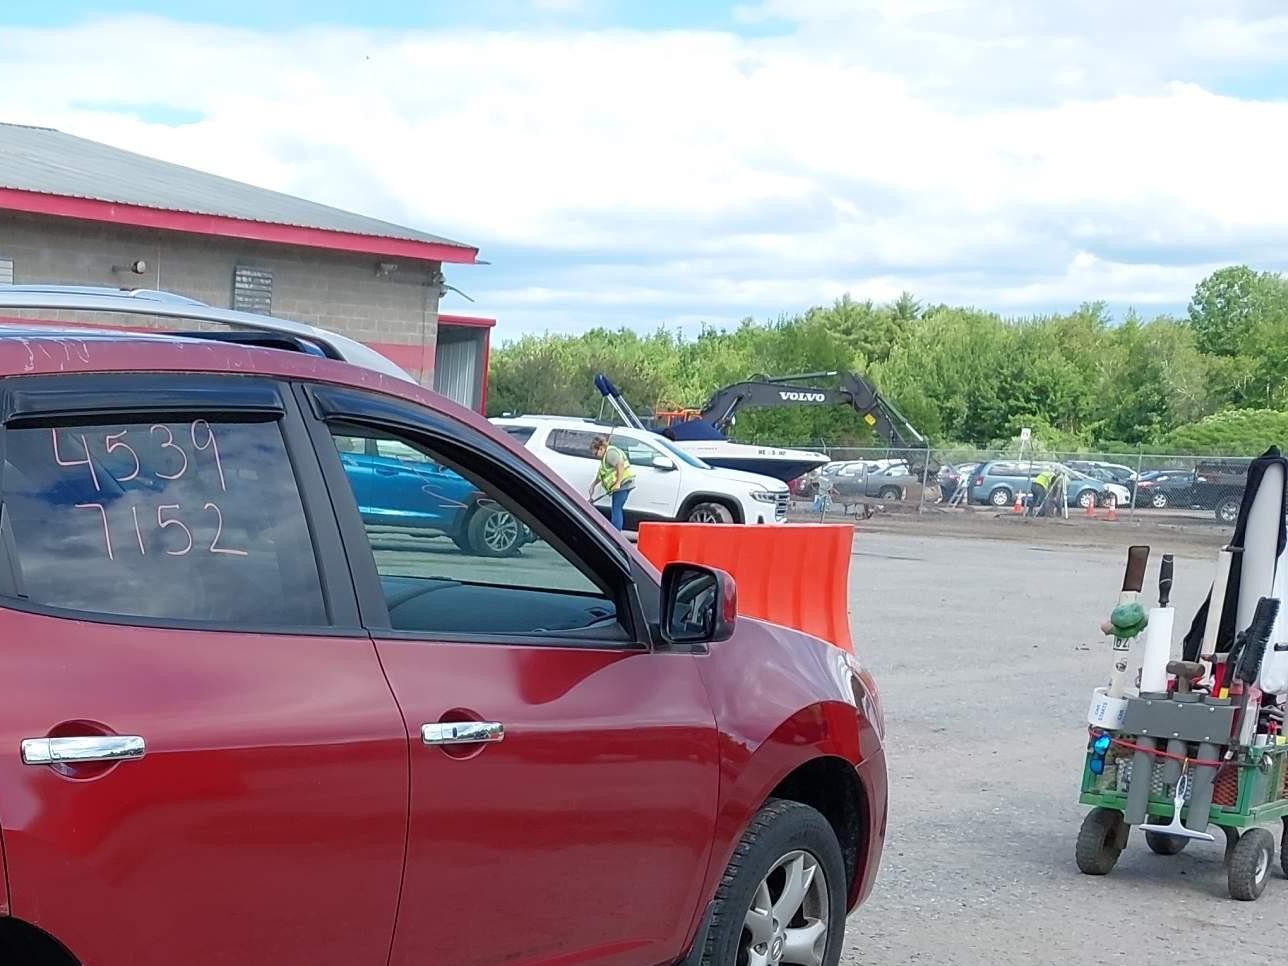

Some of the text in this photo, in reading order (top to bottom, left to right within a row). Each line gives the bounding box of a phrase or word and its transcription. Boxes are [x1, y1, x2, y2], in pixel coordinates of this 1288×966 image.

[779, 391, 825, 402] VOLVO
[52, 418, 226, 492] 4539
[74, 503, 249, 561] 7152
